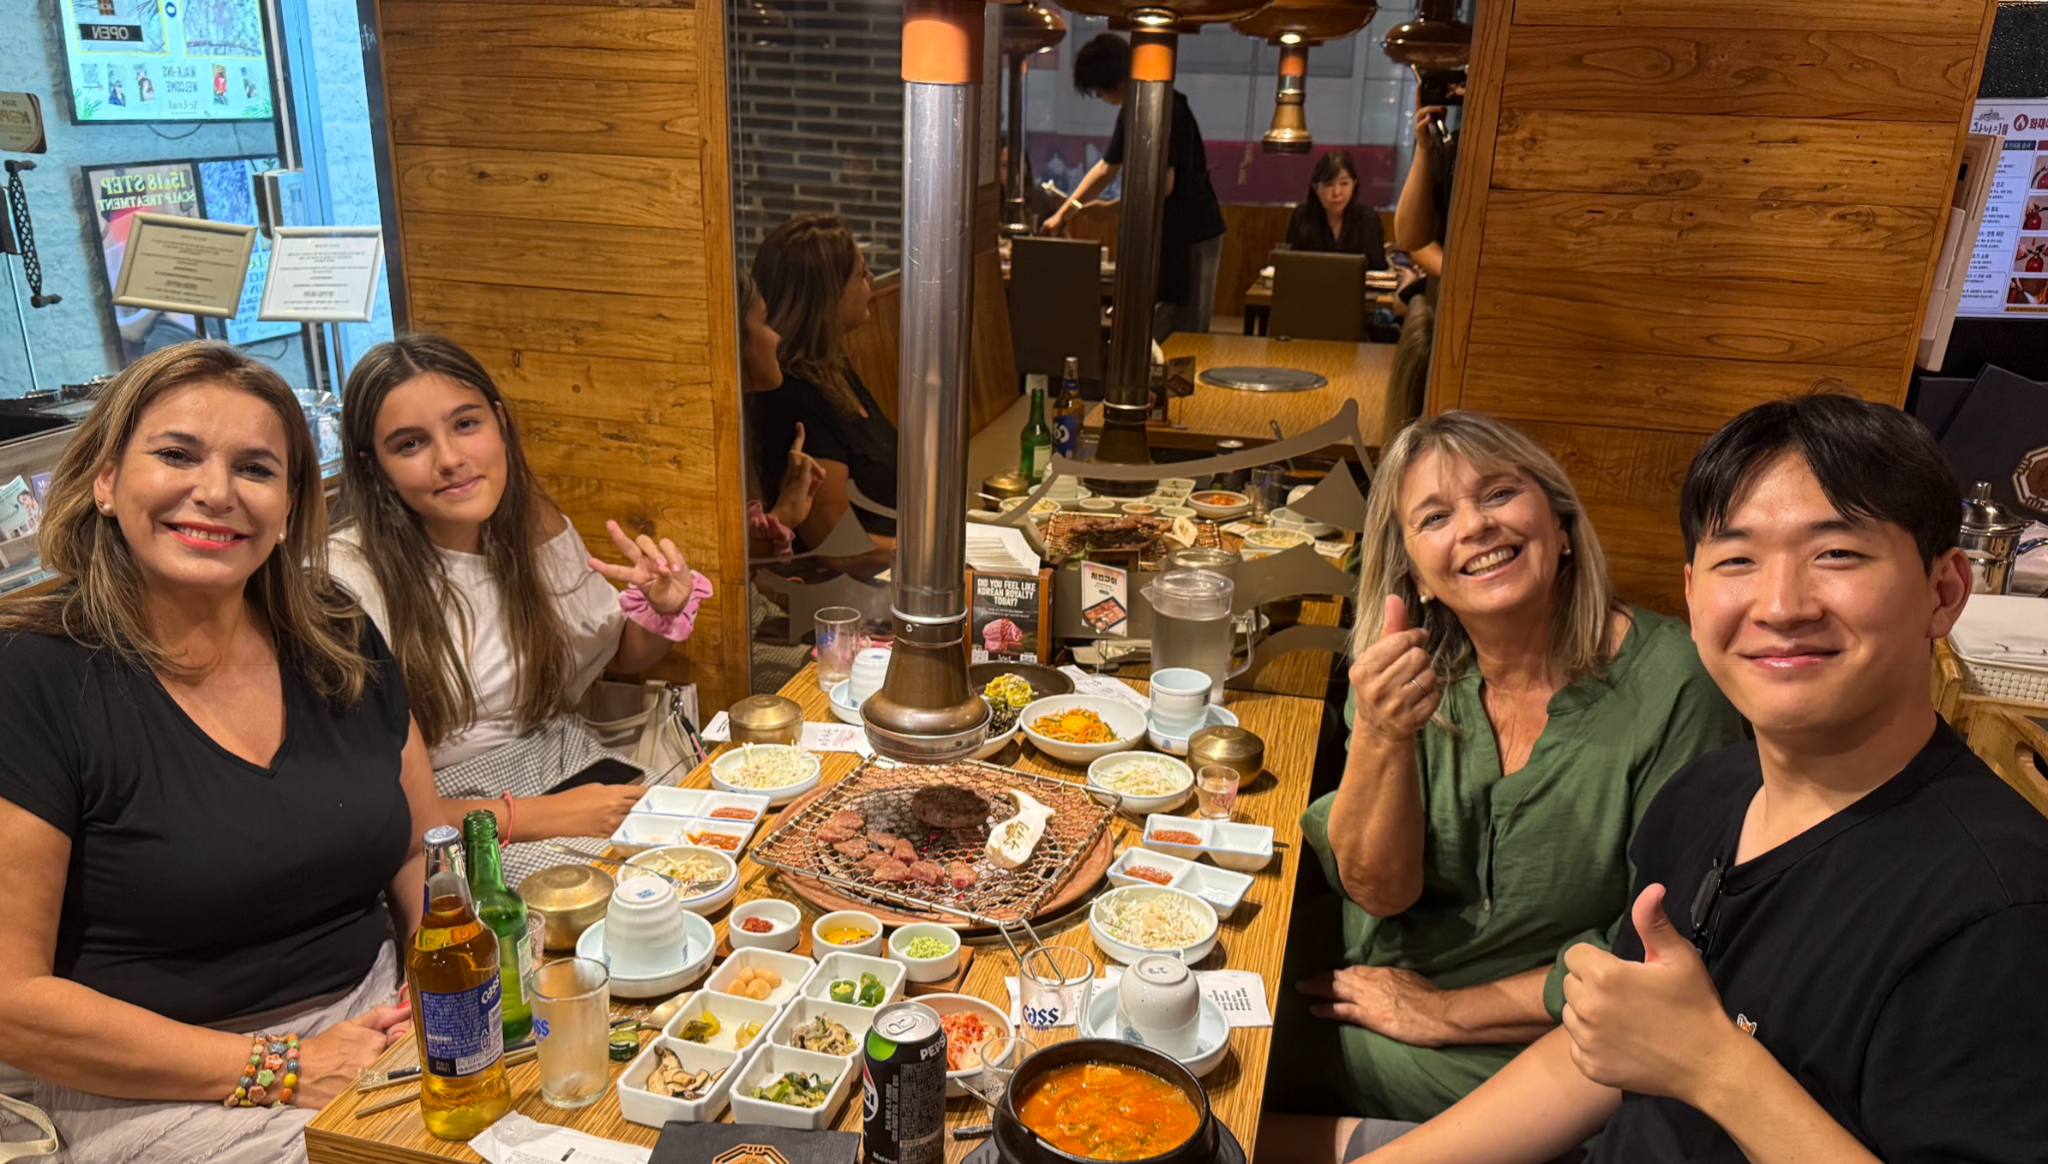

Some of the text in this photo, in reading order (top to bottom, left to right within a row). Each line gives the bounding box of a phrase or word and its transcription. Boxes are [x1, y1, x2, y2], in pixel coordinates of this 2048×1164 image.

[977, 578, 1036, 592] DID YOU FEEL LIKE
[977, 586, 1034, 600] KOREAN ROYALTY
[994, 596, 1019, 607] TODAY?
[1022, 1004, 1059, 1025] Cass
